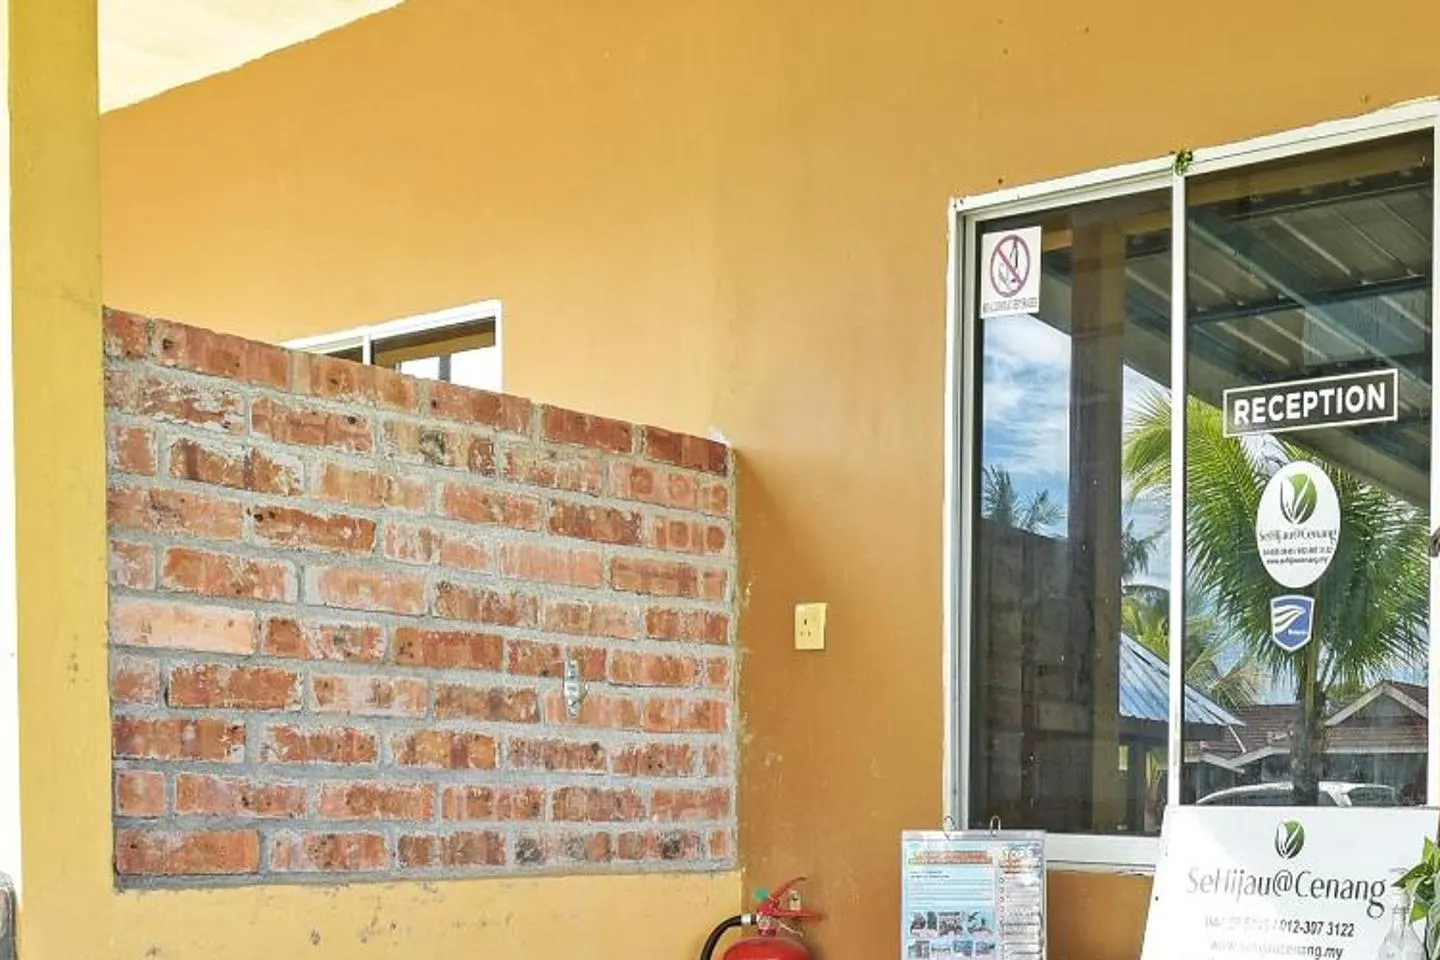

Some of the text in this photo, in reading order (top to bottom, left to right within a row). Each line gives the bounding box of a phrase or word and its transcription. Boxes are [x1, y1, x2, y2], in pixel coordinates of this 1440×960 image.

[1234, 382, 1385, 426] RECEPTION
[1279, 918, 1324, 936] 012-307
[1326, 921, 1355, 938] 3122
